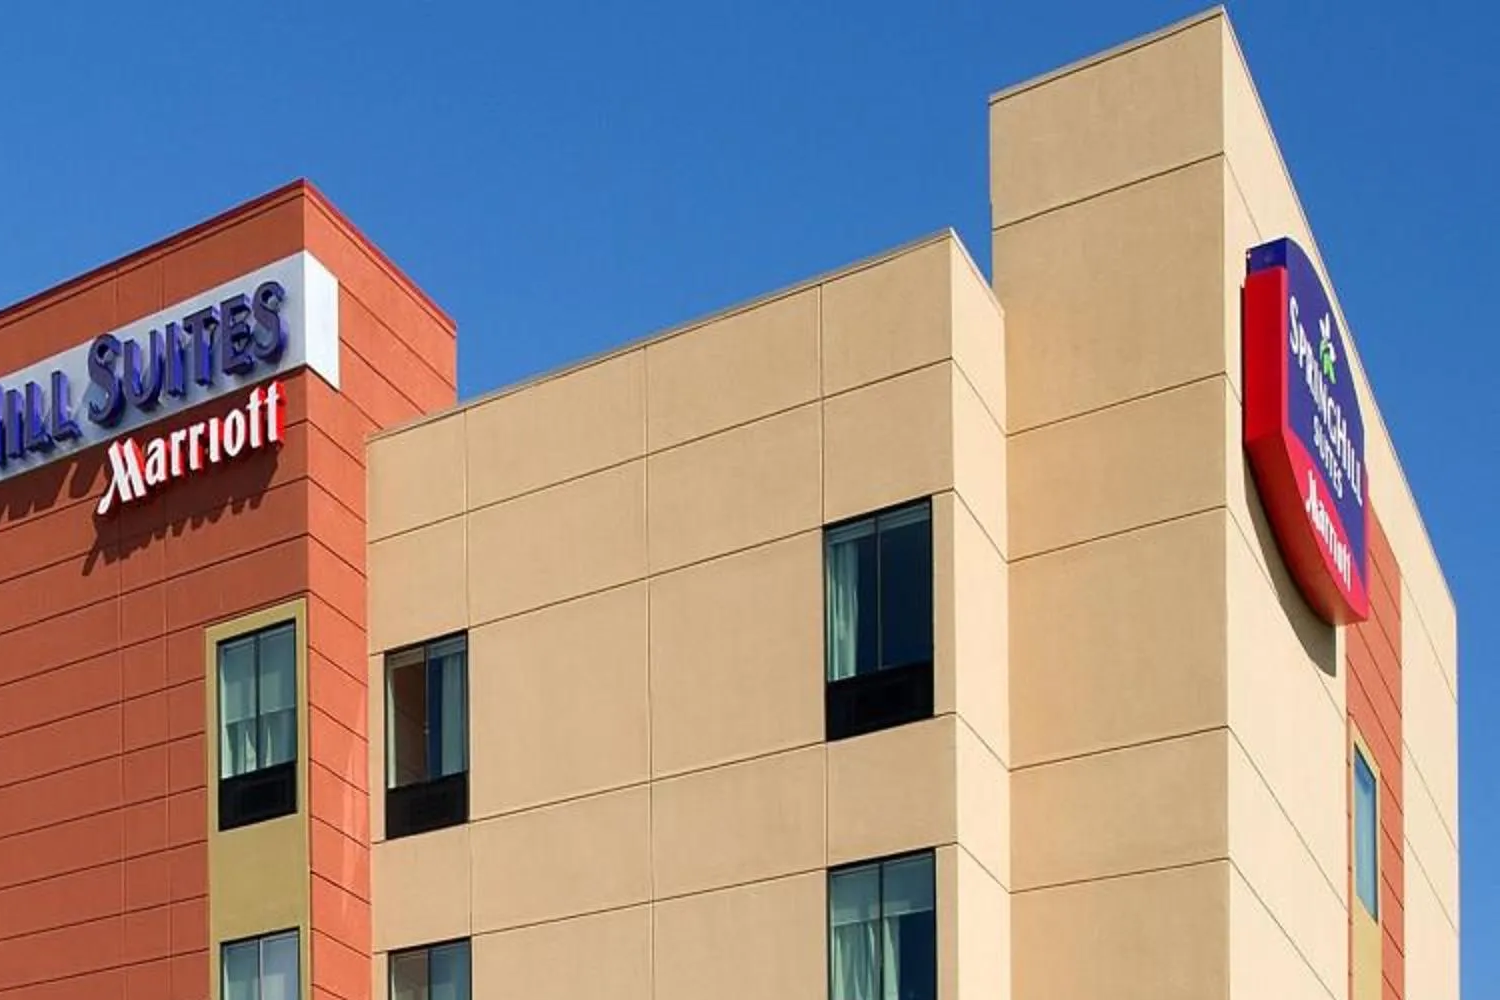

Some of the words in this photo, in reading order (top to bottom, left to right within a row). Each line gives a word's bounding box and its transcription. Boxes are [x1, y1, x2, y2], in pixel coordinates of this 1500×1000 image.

[87, 281, 285, 427] SUITES
[97, 380, 285, 514] Marriott
[1305, 470, 1351, 592] Marriott
